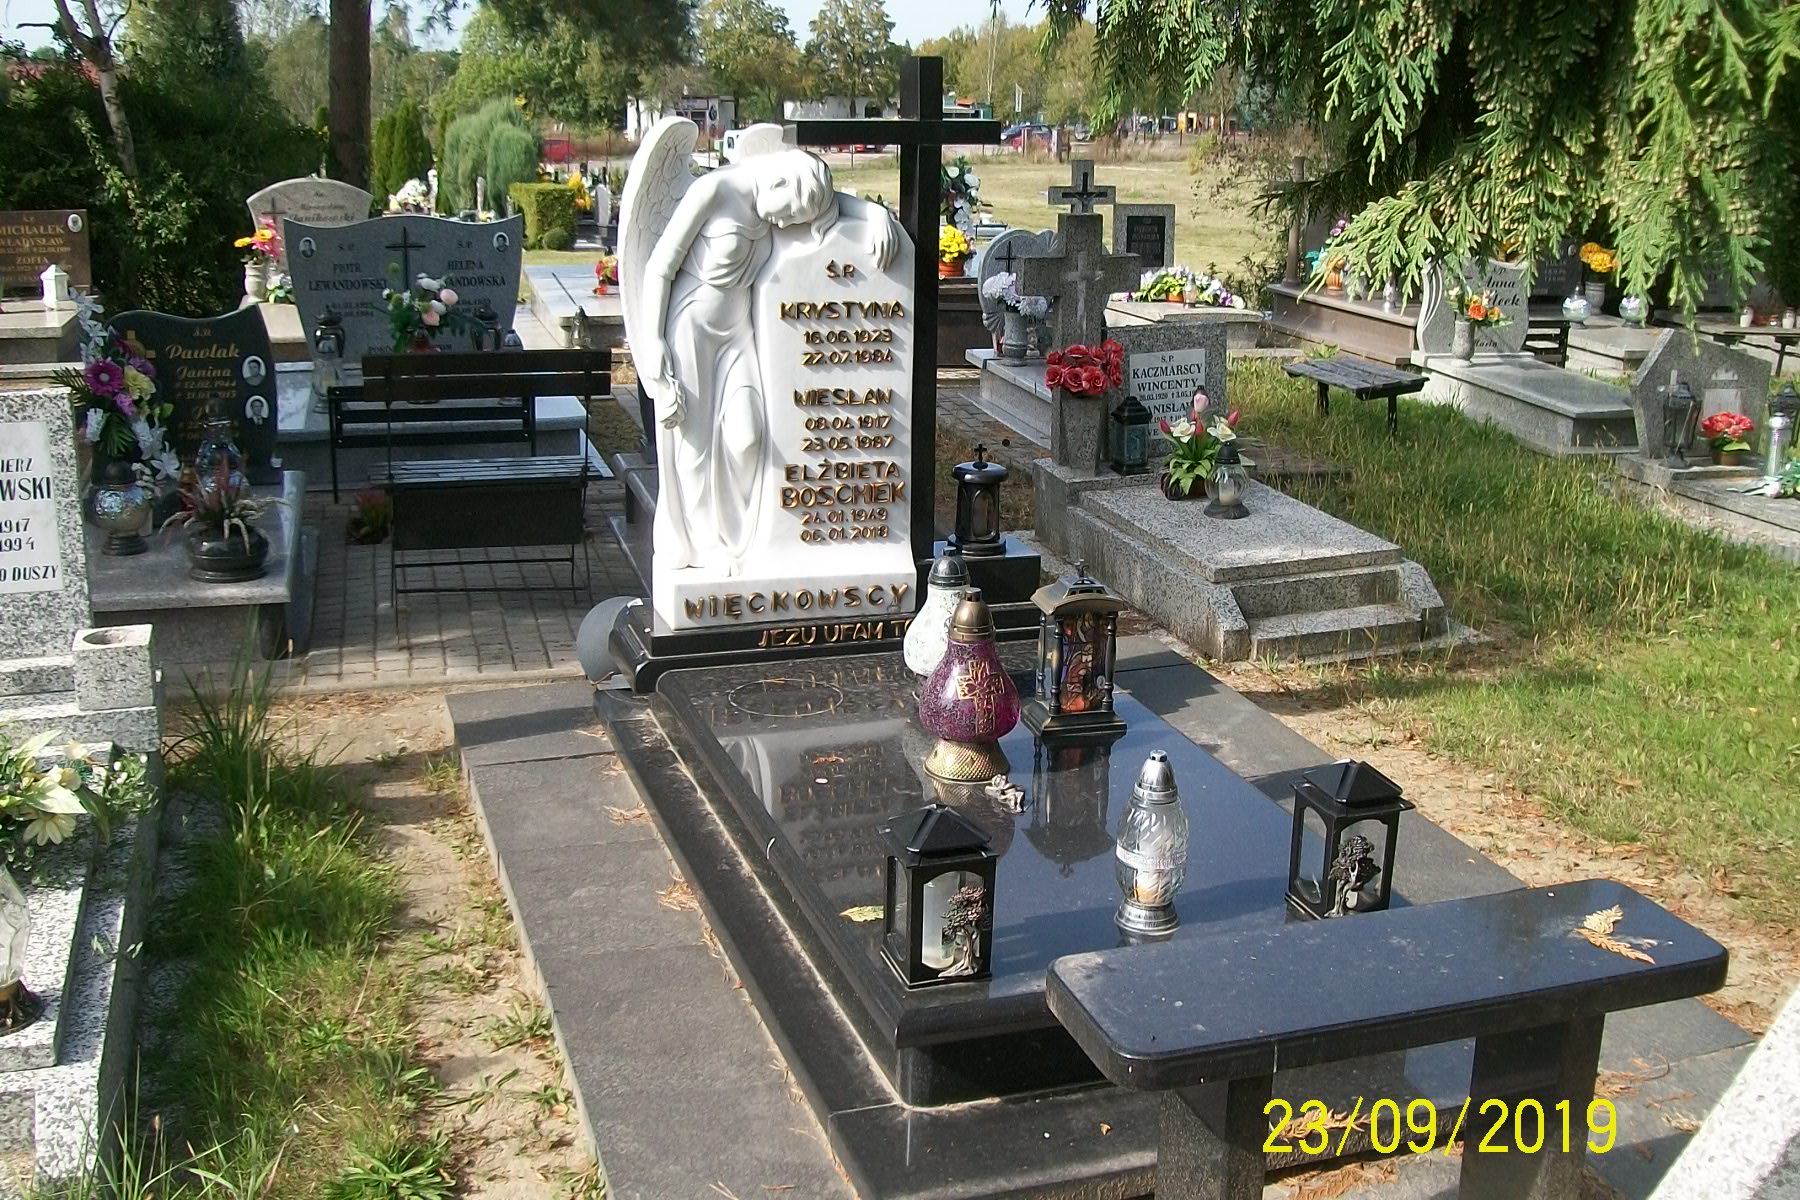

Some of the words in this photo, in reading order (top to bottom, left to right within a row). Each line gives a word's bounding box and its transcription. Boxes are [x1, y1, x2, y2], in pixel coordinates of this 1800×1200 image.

[308, 277, 387, 291] LEWANDOWSKI
[444, 275, 506, 287] ANDOWSKA
[779, 301, 905, 320] KRYSTYNA
[803, 328, 892, 345] 16.06.1923
[165, 343, 240, 360] Pawlak
[801, 349, 893, 366] 22.07.1984
[176, 366, 232, 381] Janina
[1132, 363, 1203, 379] KACZMARSCY
[1137, 378, 1199, 392] WINCENTY
[804, 415, 891, 431] 08.04.1917
[801, 434, 895, 451] 23.05.1987
[784, 458, 900, 482] ELŻBIETA
[779, 480, 907, 509] BOSCHEK
[800, 507, 888, 525] 24.01.1949
[800, 524, 889, 542] 06.01.2018
[12, 565, 58, 582] DUSZY
[684, 582, 909, 620] WIĘCKOWSCY
[757, 625, 817, 648] JEZU
[824, 621, 884, 643] UFAM
